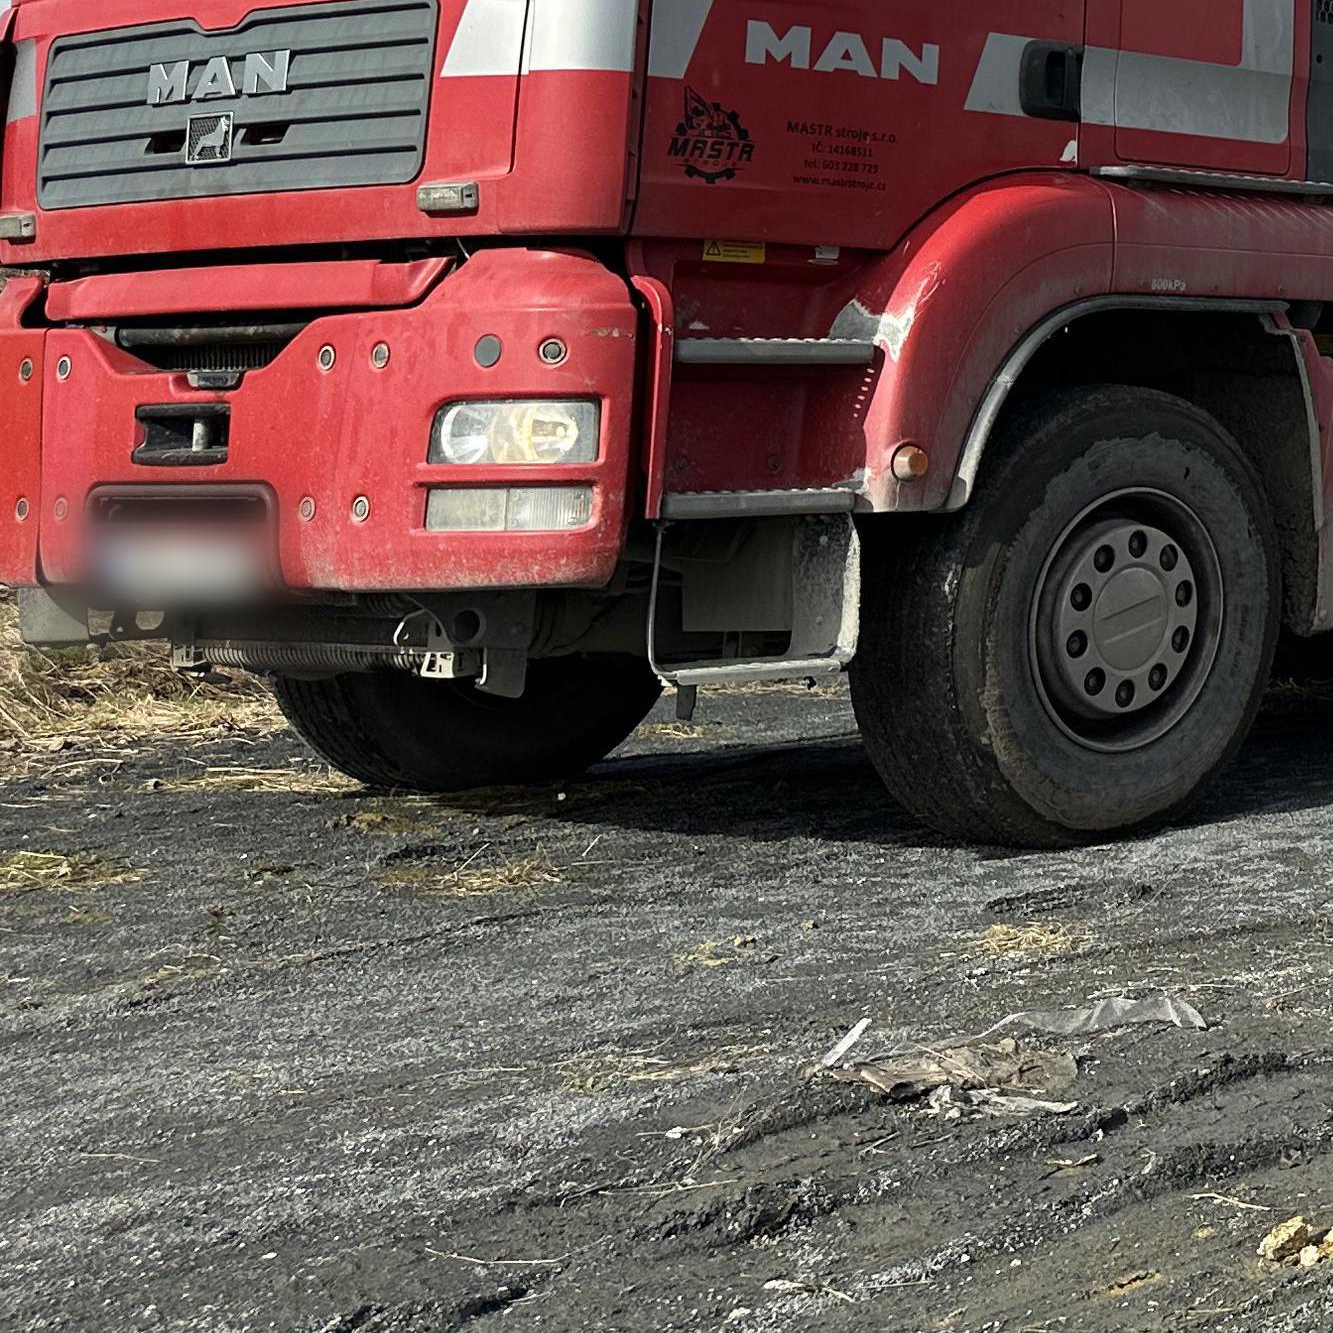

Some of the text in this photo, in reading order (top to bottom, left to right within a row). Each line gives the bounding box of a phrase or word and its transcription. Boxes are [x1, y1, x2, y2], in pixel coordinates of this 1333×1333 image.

[745, 19, 940, 85] MAN
[147, 49, 291, 105] MAN
[667, 137, 755, 163] MASTR
[786, 121, 833, 137] MASTR
[835, 126, 869, 142] stroje
